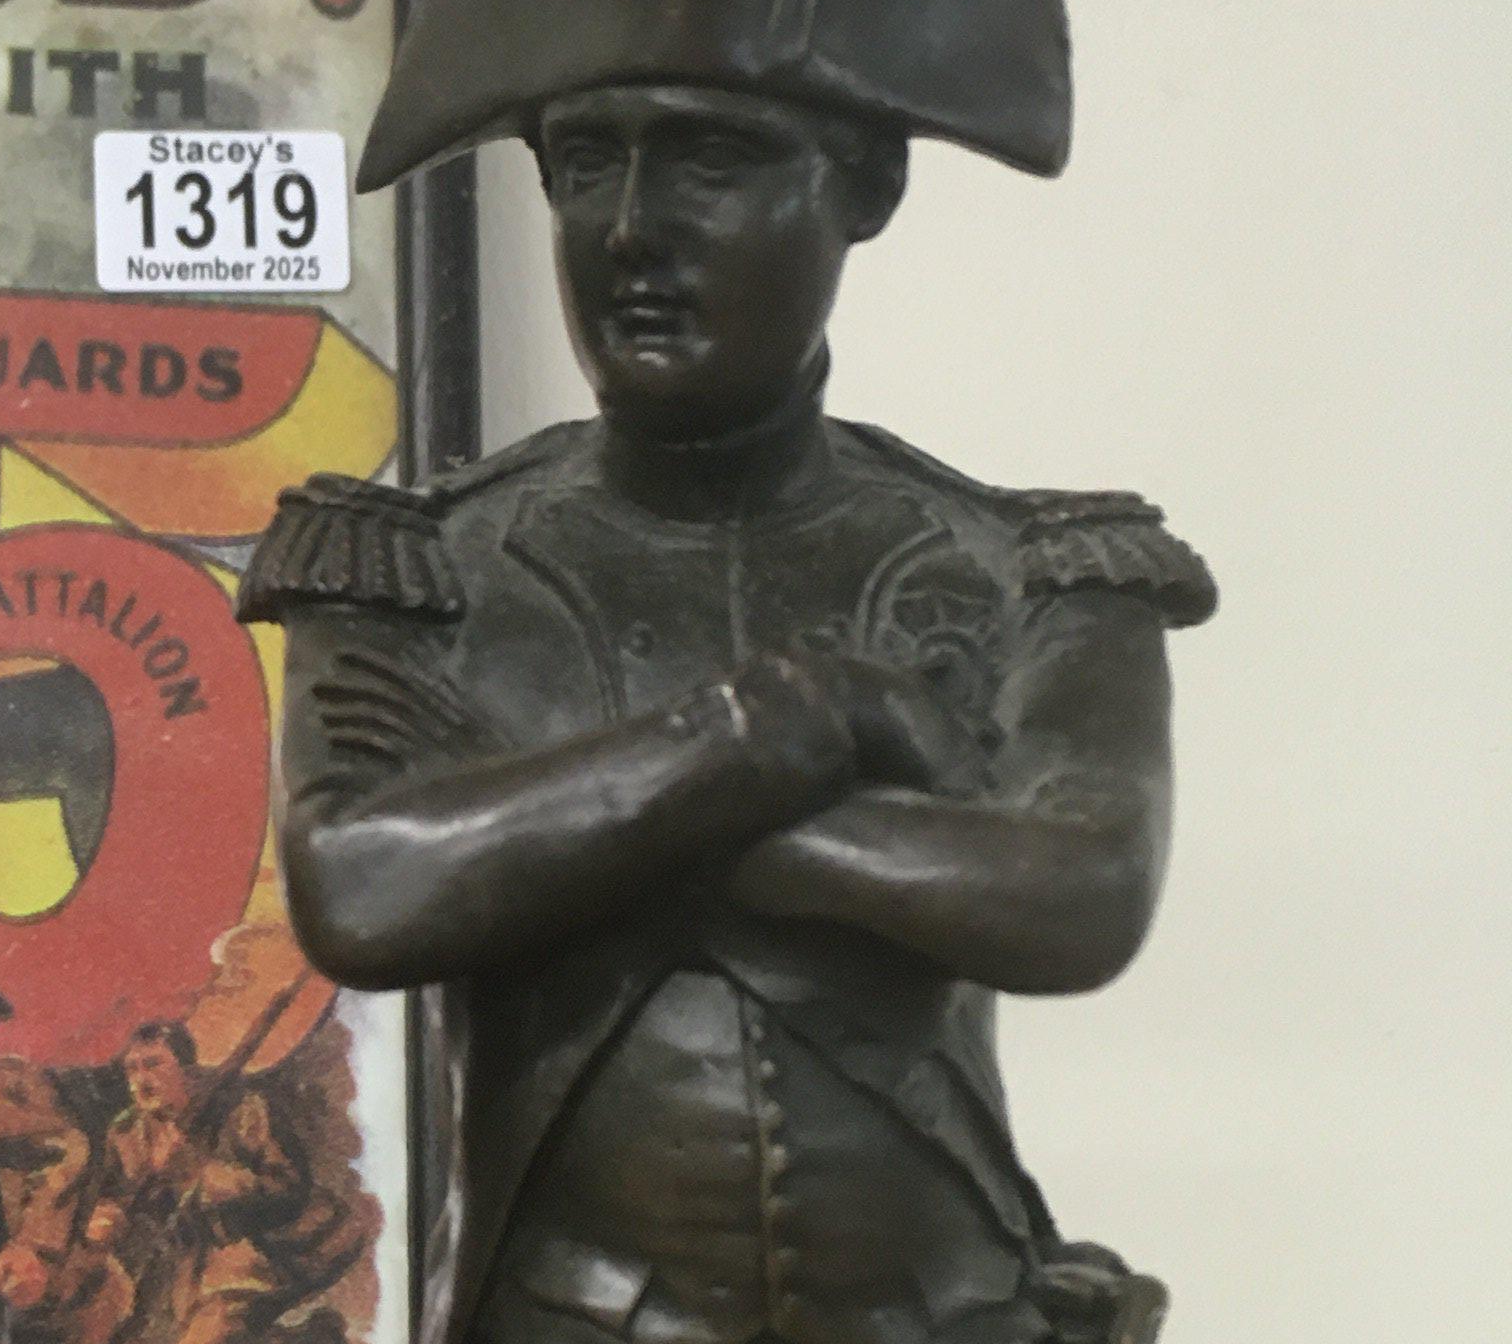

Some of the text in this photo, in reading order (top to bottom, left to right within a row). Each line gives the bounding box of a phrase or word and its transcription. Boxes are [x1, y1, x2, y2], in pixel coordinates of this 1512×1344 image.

[149, 135, 294, 171] Stacey's
[126, 170, 317, 249] 1319
[127, 256, 321, 282] November 2025
